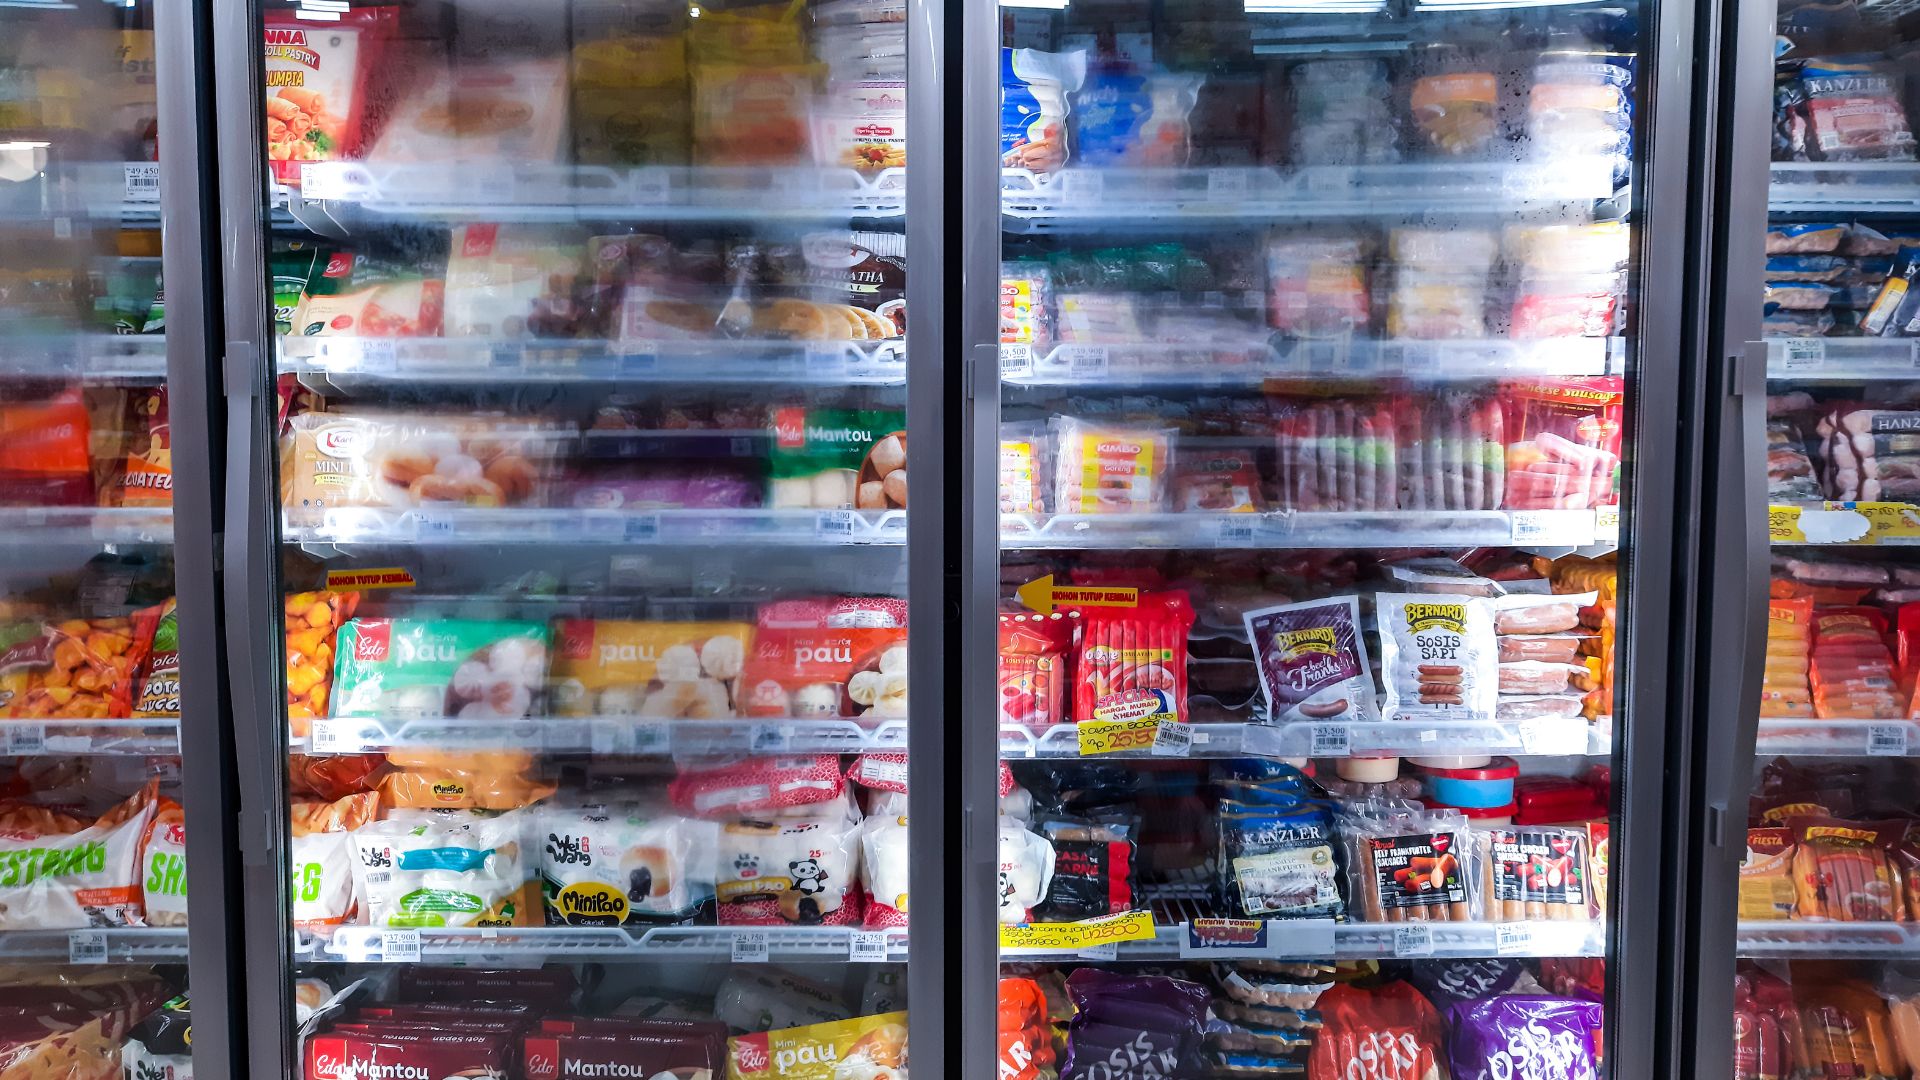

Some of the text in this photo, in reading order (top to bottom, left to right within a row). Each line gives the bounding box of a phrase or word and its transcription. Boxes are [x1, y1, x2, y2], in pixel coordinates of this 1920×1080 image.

[284, 47, 318, 66] PASTRY
[1810, 79, 1887, 94] KANZLER
[130, 167, 159, 178] 49,450
[808, 426, 873, 443] Mantou
[1096, 443, 1142, 454] KIMBO
[315, 460, 344, 474] MINI
[357, 574, 381, 586] TUTUP
[1052, 591, 1136, 602] MOHON TUTUP KEMBALI
[1404, 603, 1468, 625] BERNARDI
[360, 637, 385, 656] Edo
[1278, 627, 1337, 653] BERNARDI
[397, 643, 457, 668] pau
[599, 644, 656, 667] pau
[794, 647, 852, 671] pau
[1421, 648, 1457, 660] SAPI
[1309, 655, 1327, 671] beef
[1097, 687, 1158, 709] SPECIAL
[1100, 700, 1158, 716] HARGA MURAH
[1119, 709, 1146, 719] HEMAT
[1164, 720, 1191, 733] 73,900
[1317, 726, 1346, 735] 83,500
[549, 833, 580, 851] Wei
[1243, 826, 1321, 845] KANZLER
[545, 845, 592, 867] Wang
[809, 849, 821, 858] 25
[1376, 855, 1408, 867] SAUSAGES
[1001, 862, 1013, 871] 25
[562, 890, 625, 913] MiniPao
[1229, 919, 1255, 927] HARGA
[388, 933, 416, 942] 37,900
[737, 933, 764, 942] 24,750
[857, 933, 884, 942] 24,750
[775, 1039, 796, 1048] Mini
[528, 1055, 554, 1074] Edo
[777, 1043, 838, 1075] pau
[351, 1059, 429, 1080] Mantou
[564, 1059, 643, 1078] Mantou
